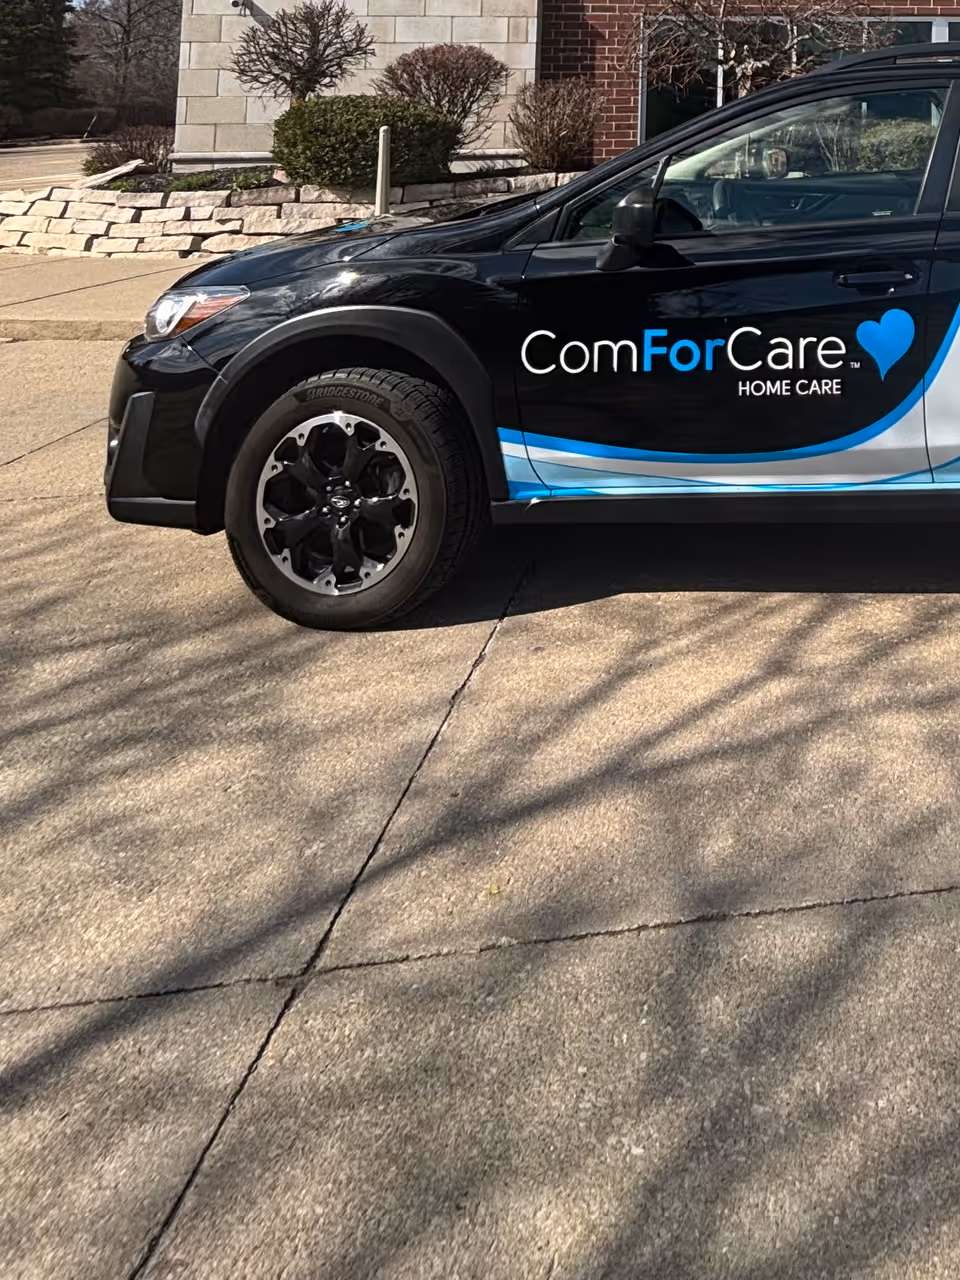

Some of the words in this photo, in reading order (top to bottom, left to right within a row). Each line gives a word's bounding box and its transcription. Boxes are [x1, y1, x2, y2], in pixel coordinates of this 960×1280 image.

[521, 326, 846, 374] ComForCare
[306, 385, 385, 407] BRIDGESTONE
[738, 380, 791, 396] HOME
[796, 379, 842, 395] CARE
